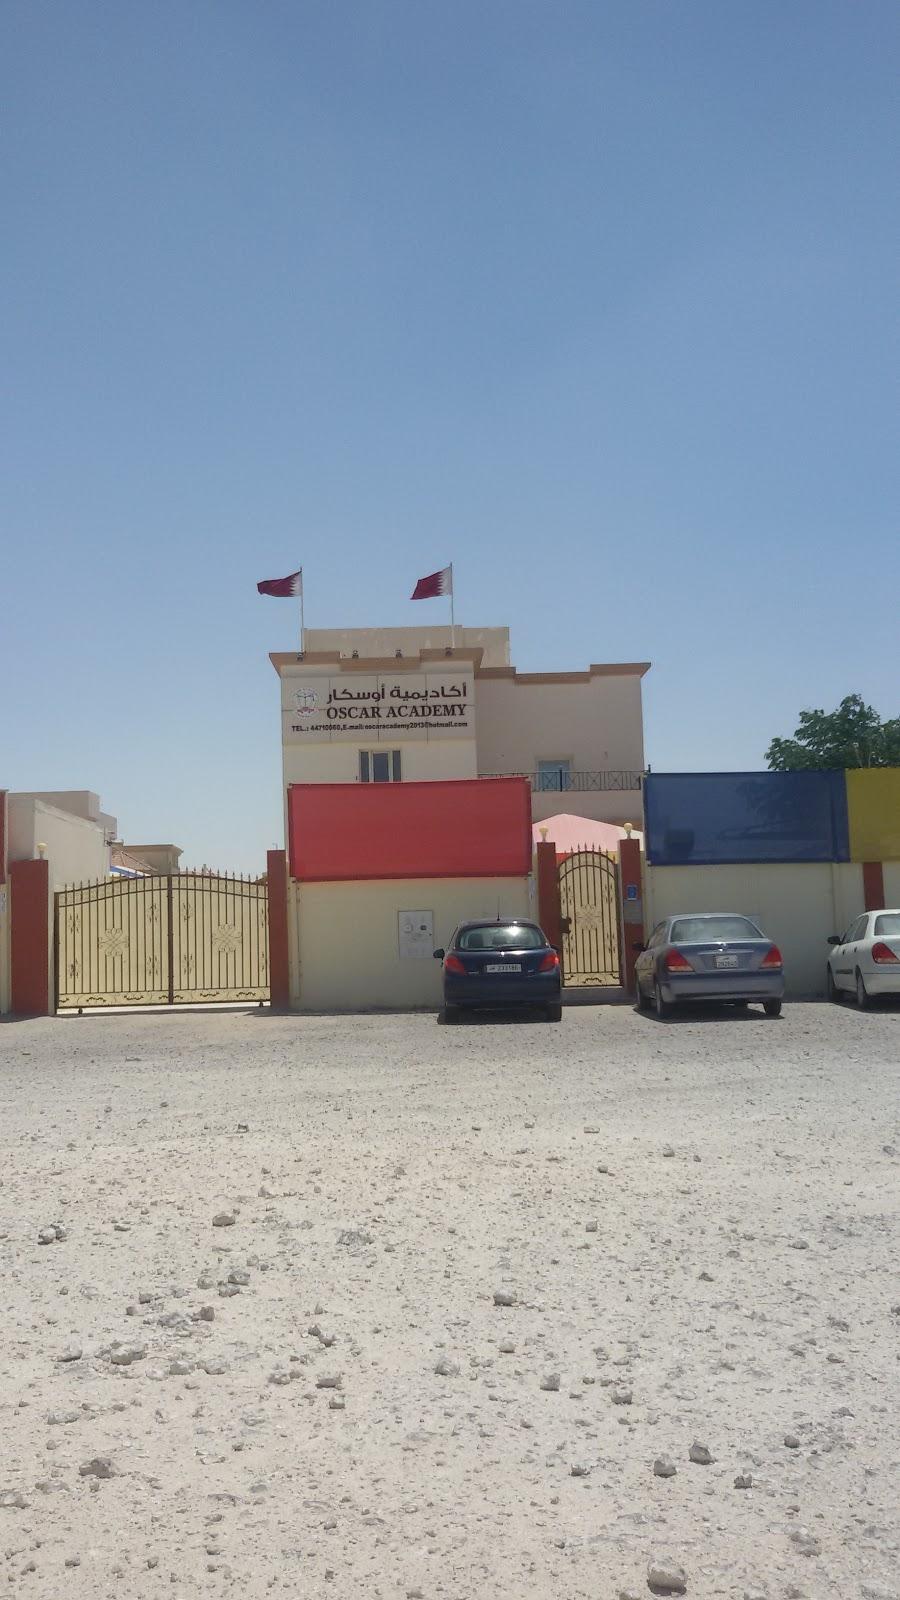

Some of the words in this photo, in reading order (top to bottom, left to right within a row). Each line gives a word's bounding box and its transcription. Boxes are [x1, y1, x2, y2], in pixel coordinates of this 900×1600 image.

[327, 684, 385, 704] أوسكار
[390, 682, 467, 701] أكاديمية
[326, 706, 382, 719] OSCAR
[386, 704, 467, 718] ACADEMY
